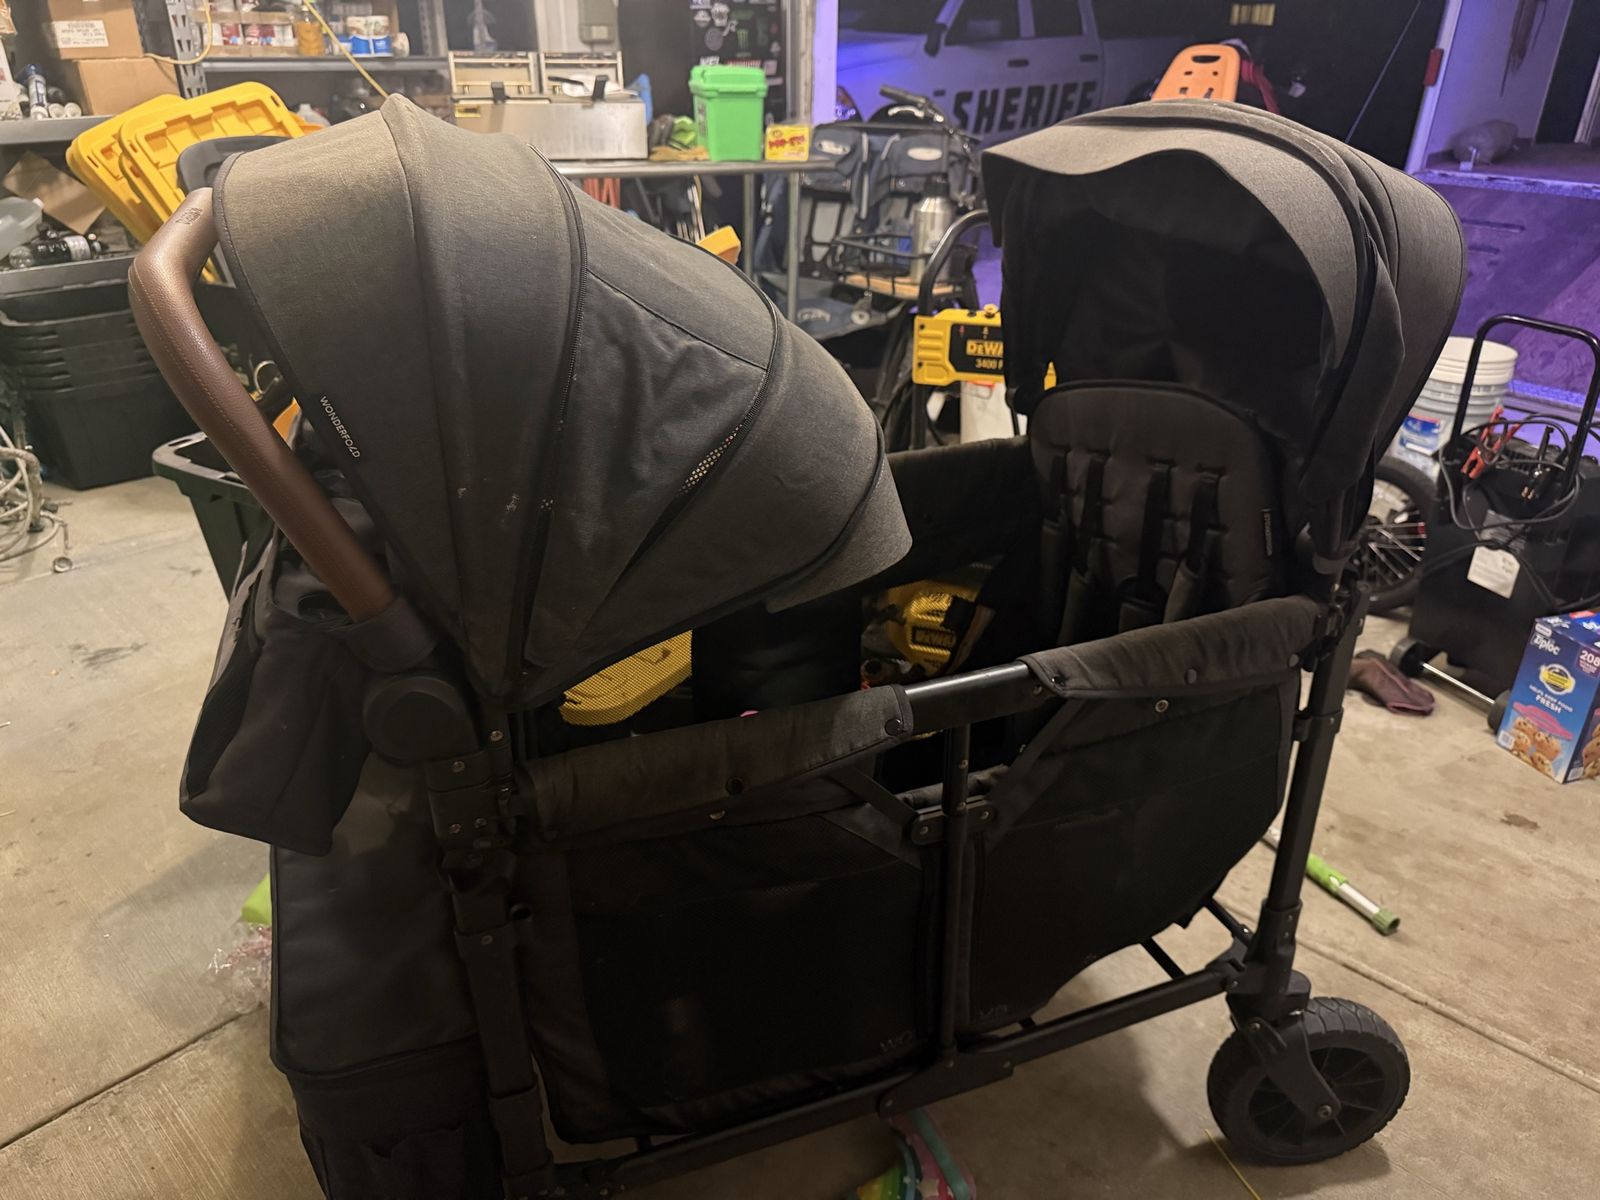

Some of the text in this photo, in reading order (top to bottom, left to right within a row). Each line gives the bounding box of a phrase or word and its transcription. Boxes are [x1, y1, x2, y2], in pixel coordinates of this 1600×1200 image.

[953, 81, 1097, 134] SHERIFF
[320, 396, 361, 458] WONDERFOLD
[1534, 634, 1561, 656] Ziploc
[1579, 650, 1600, 667] 208
[1535, 695, 1562, 714] FRESH
